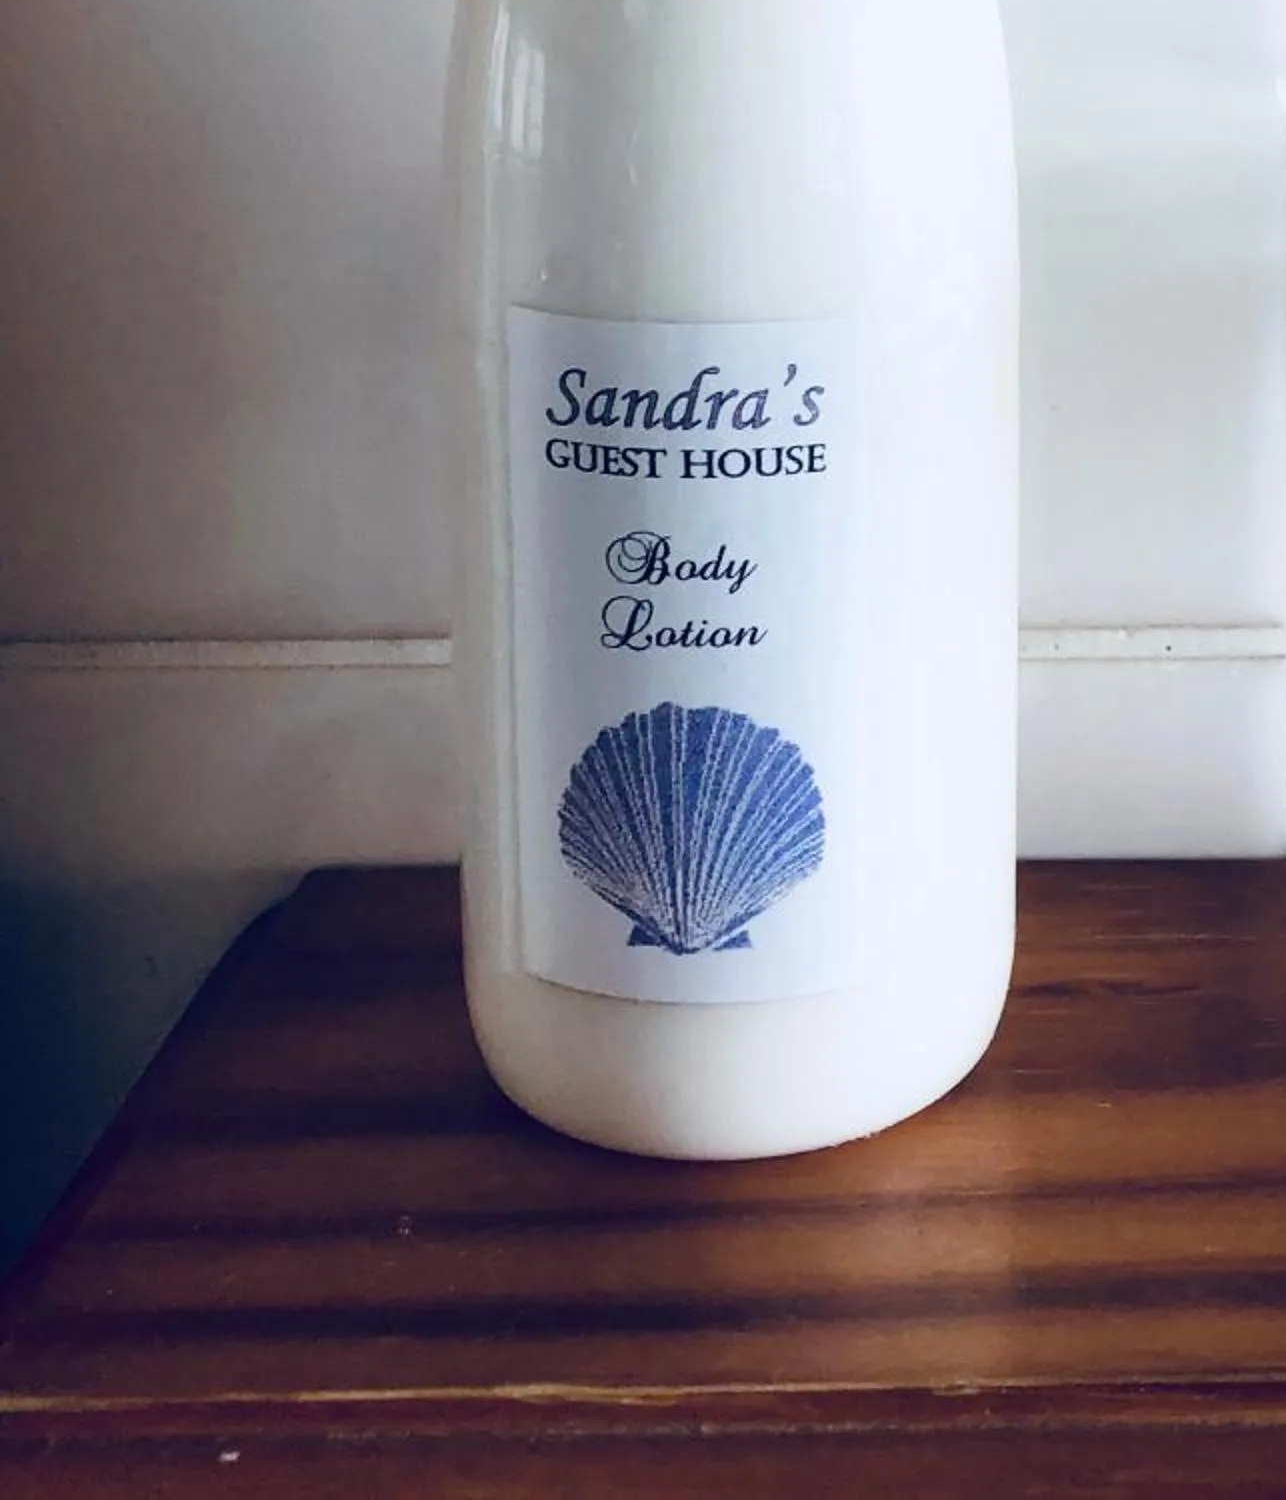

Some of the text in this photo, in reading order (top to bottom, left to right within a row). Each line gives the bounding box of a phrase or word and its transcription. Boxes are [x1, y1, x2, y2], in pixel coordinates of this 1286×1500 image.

[545, 363, 826, 431] Sandra's
[545, 438, 828, 480] GUEST HOUSE
[605, 530, 759, 596] Body
[600, 595, 769, 653] Lotion
